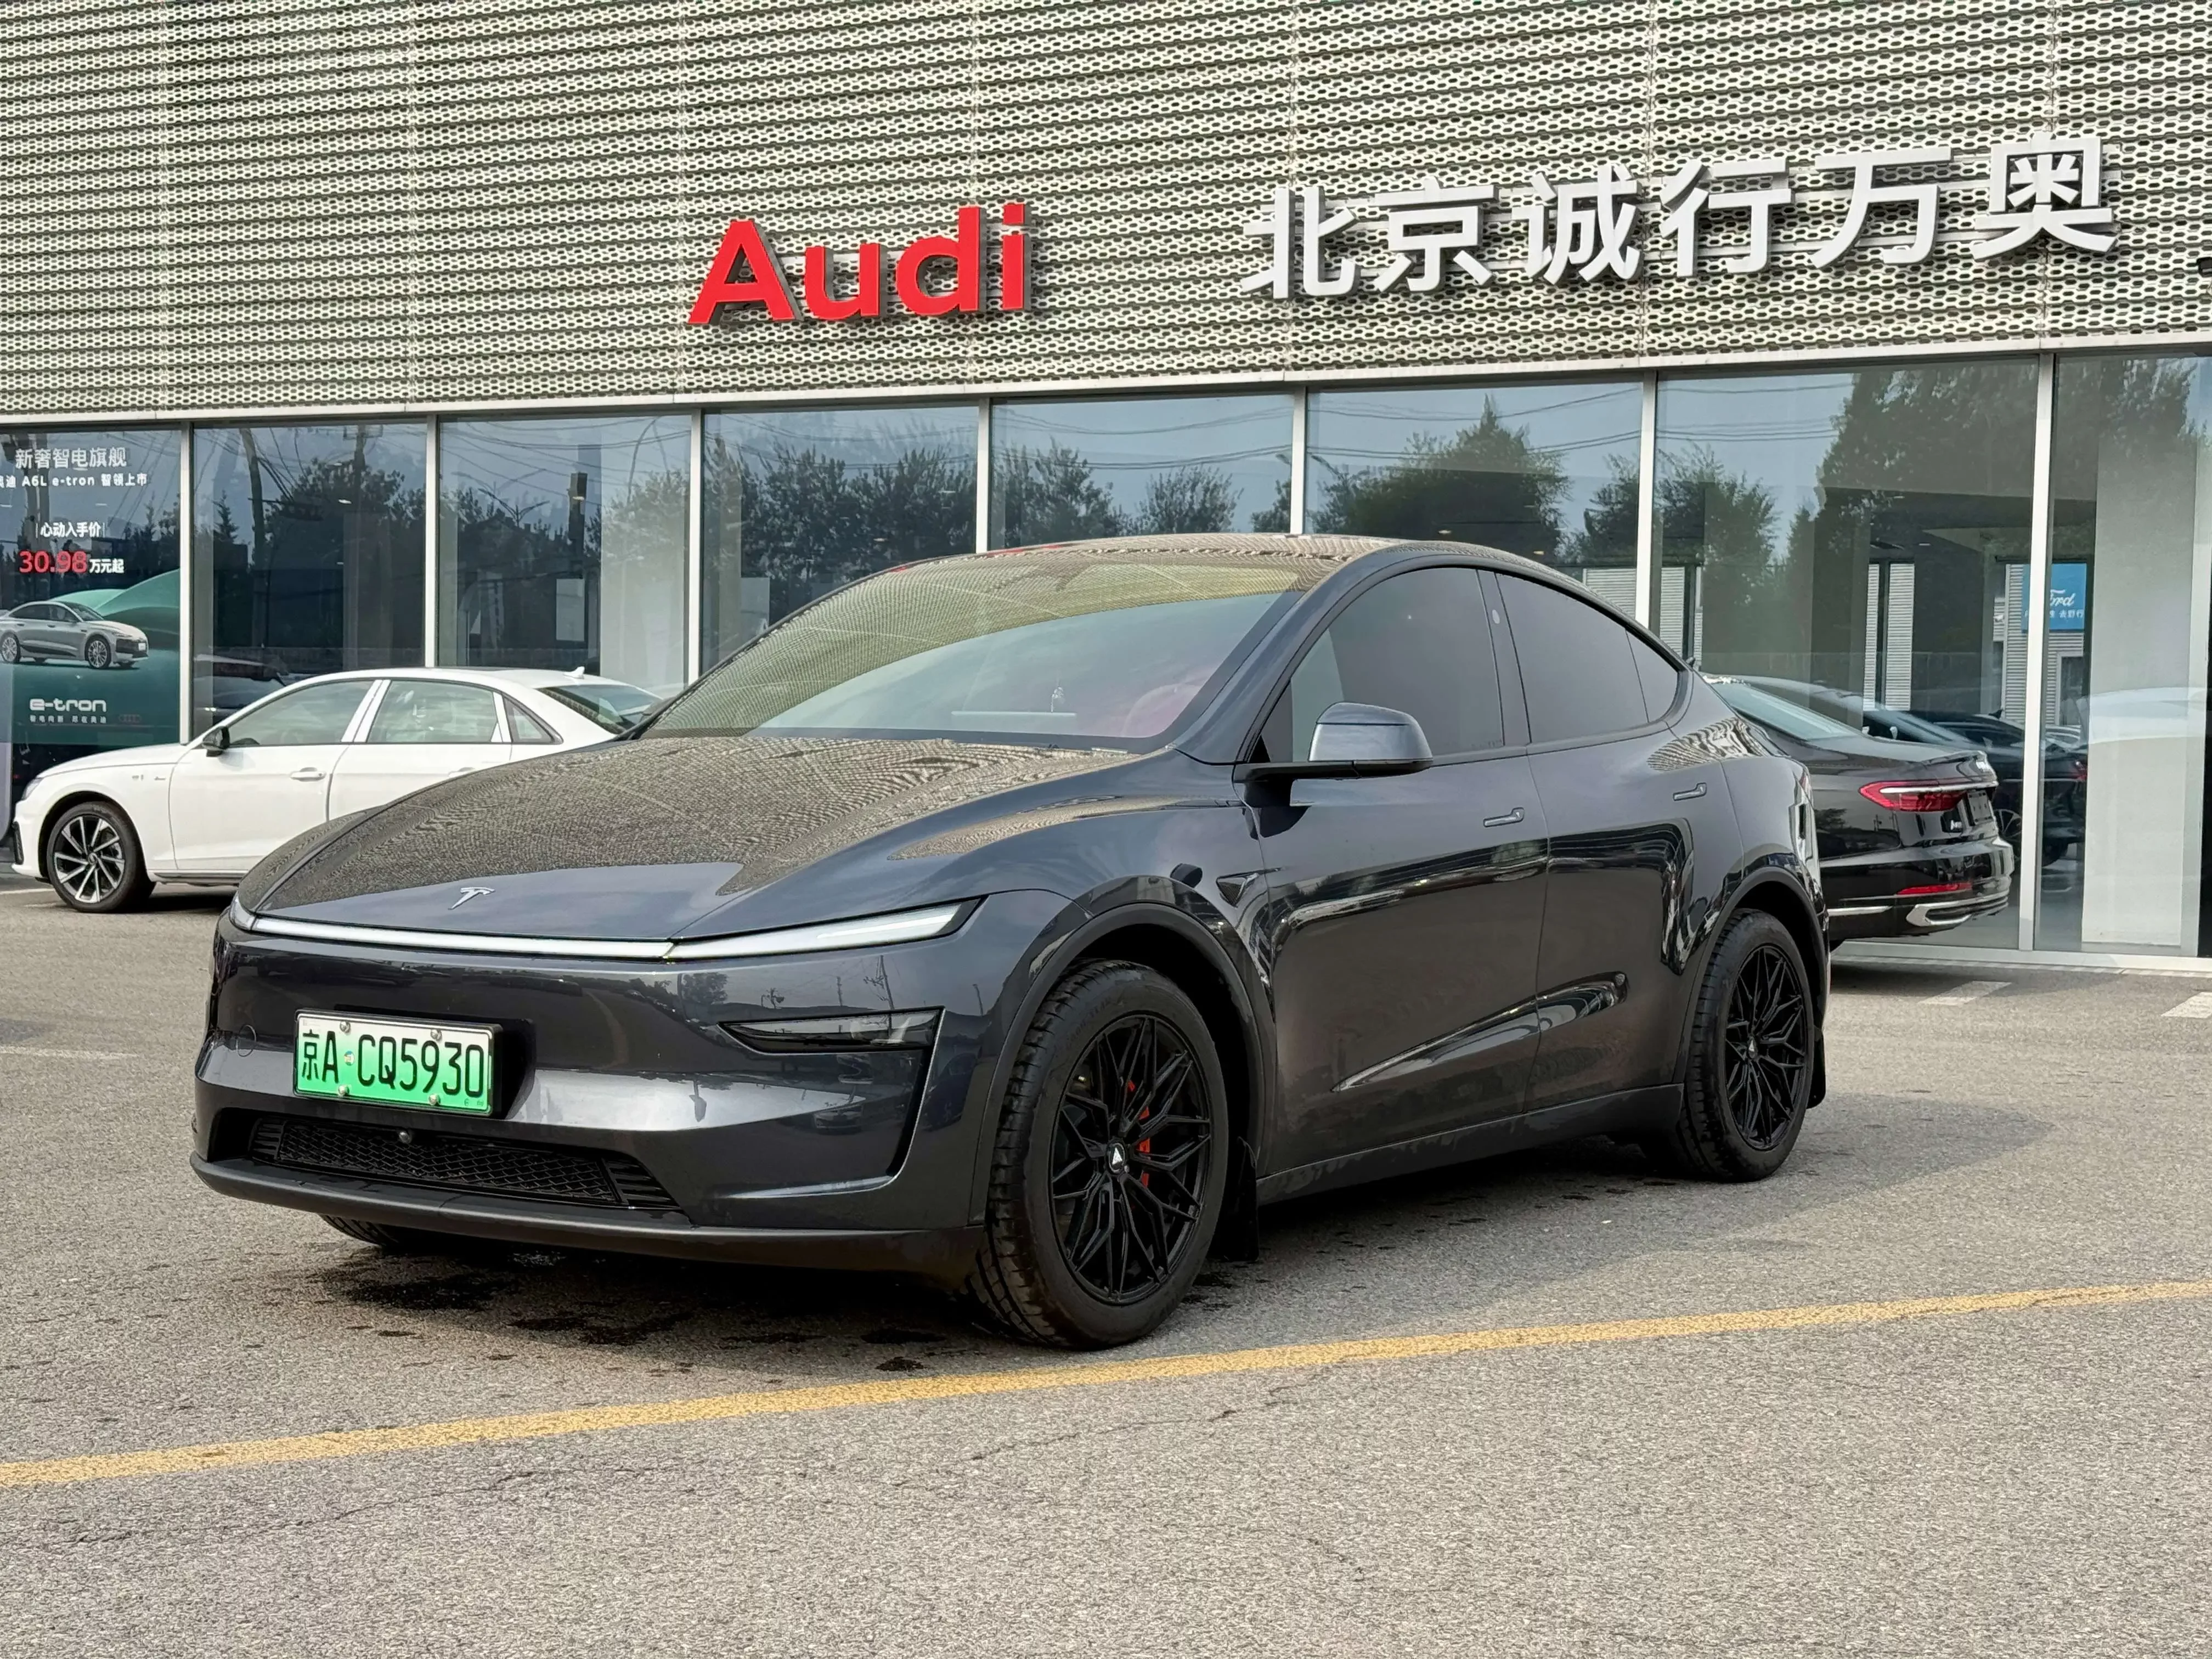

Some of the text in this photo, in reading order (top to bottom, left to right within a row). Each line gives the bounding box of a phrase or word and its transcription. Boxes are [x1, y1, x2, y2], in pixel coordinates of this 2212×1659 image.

[1240, 132, 2120, 301] 北京诚行万奥
[687, 201, 1030, 325] Audi
[15, 447, 127, 469] 新奢智电旗舰
[22, 475, 47, 487] A6L
[52, 476, 94, 487] e-tron
[101, 473, 147, 487] 智领上市
[40, 522, 101, 538] 心动入手价
[30, 698, 106, 712] e-tron
[302, 1029, 484, 1097] 京A CQ5930
